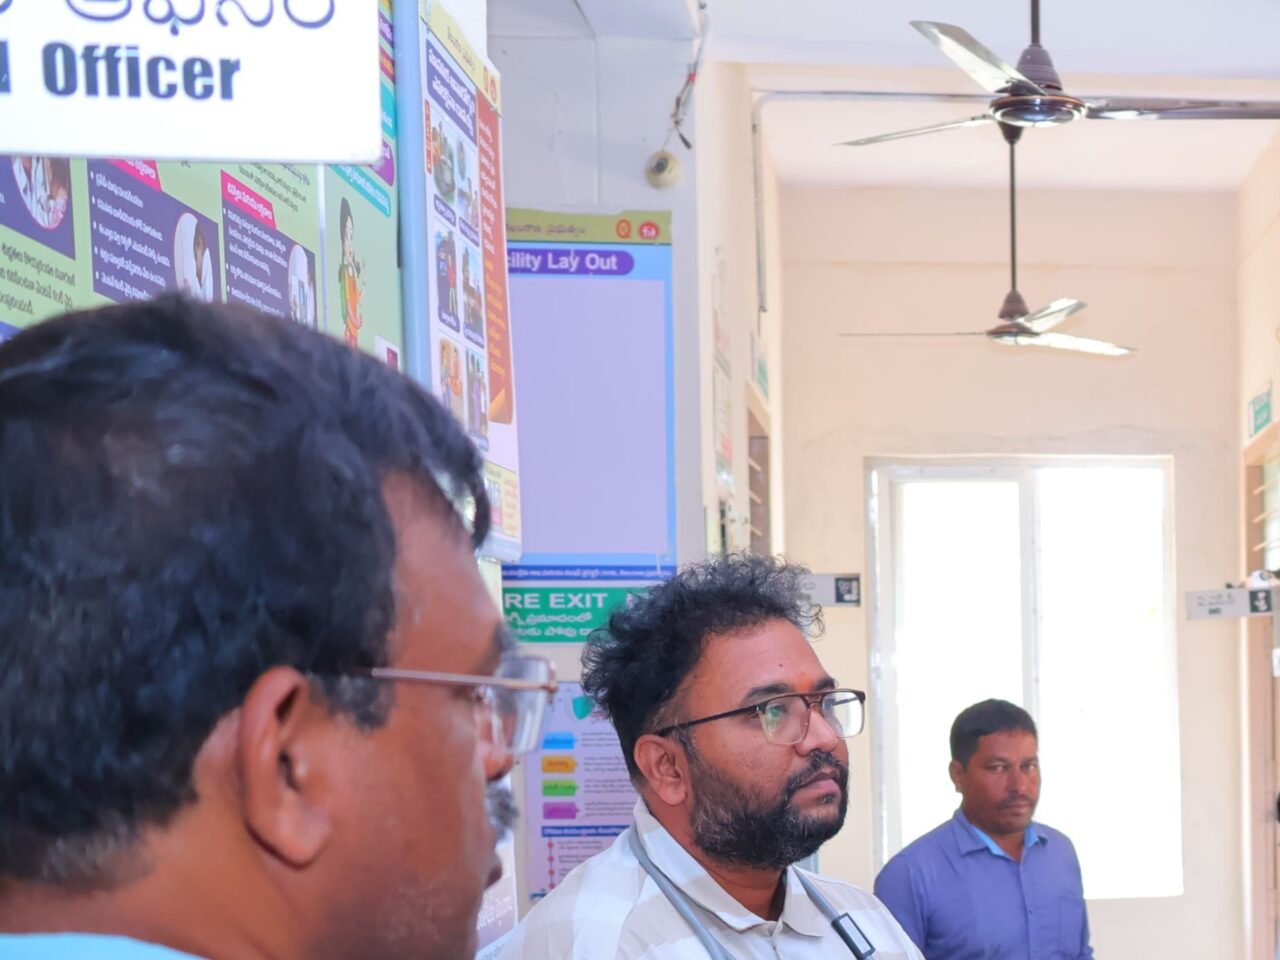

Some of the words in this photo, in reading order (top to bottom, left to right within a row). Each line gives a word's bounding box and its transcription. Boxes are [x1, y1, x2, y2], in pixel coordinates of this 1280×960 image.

[42, 41, 241, 101] Officer
[547, 252, 580, 272] Lay
[585, 252, 618, 271] Out
[504, 593, 541, 608] RE
[549, 592, 608, 608] EXIT
